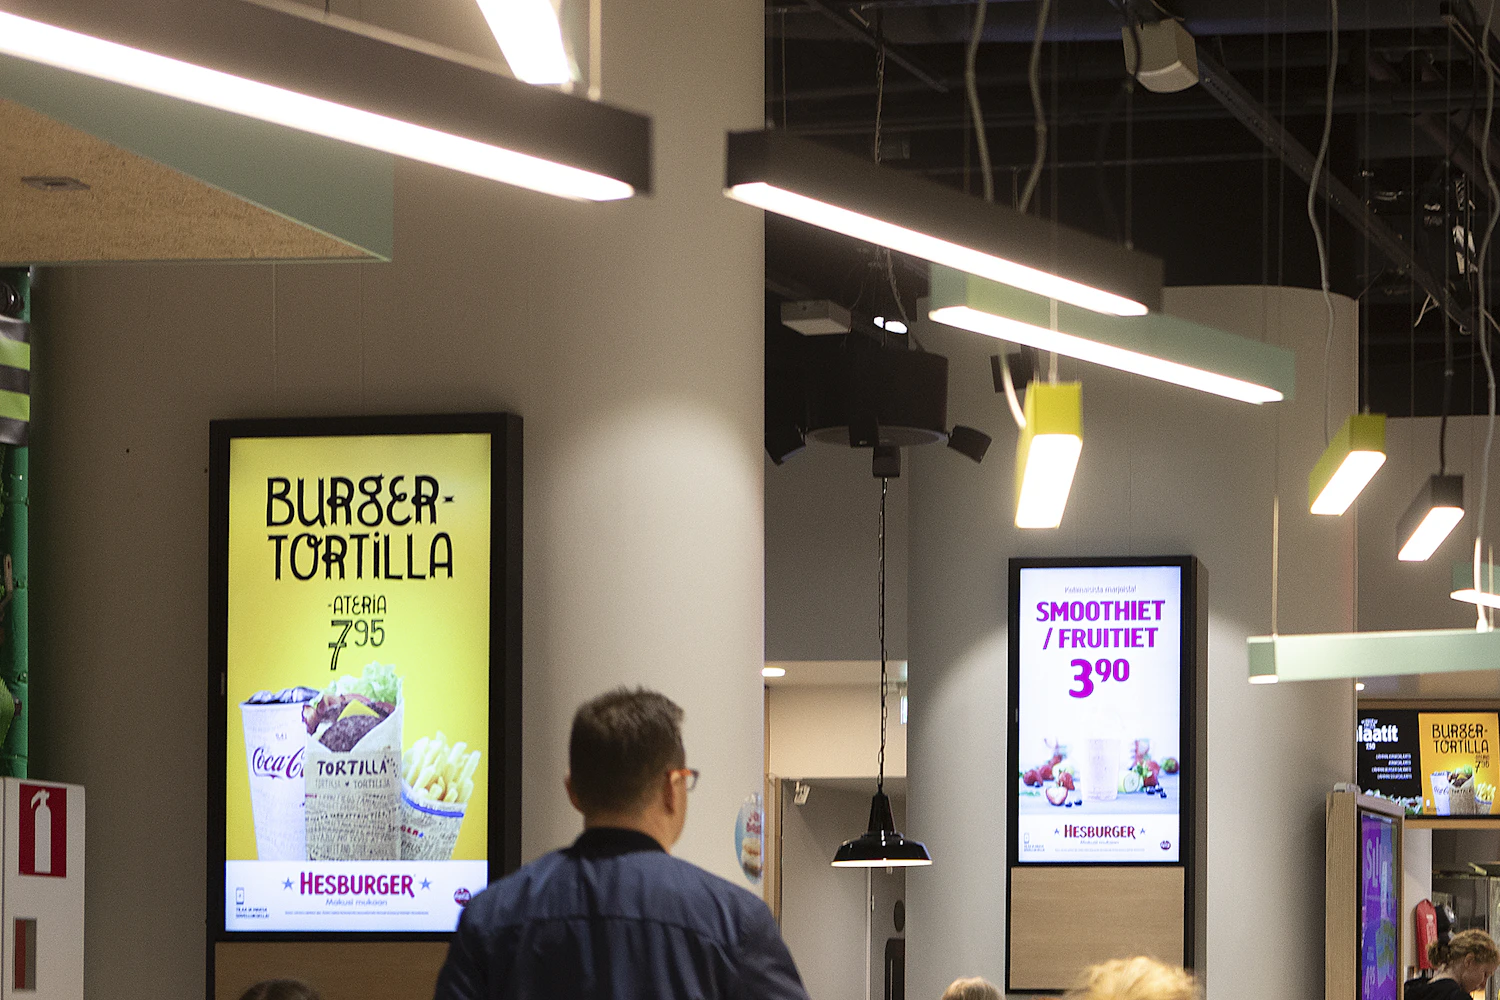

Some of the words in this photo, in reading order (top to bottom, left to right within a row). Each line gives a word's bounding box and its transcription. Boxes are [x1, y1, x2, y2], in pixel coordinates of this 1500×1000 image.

[265, 473, 455, 528] BURGER-
[268, 531, 454, 580] TORTILLA
[1036, 600, 1166, 622] SMOOTHIET
[1058, 627, 1159, 648] FRUITIET
[1356, 724, 1399, 743] laatit
[1432, 723, 1488, 739] BURGER-
[1433, 738, 1489, 754] TORTILLA
[316, 759, 387, 776] TORTILLA
[1064, 824, 1136, 840] HESBURGER
[300, 871, 416, 898] HESBURGER
